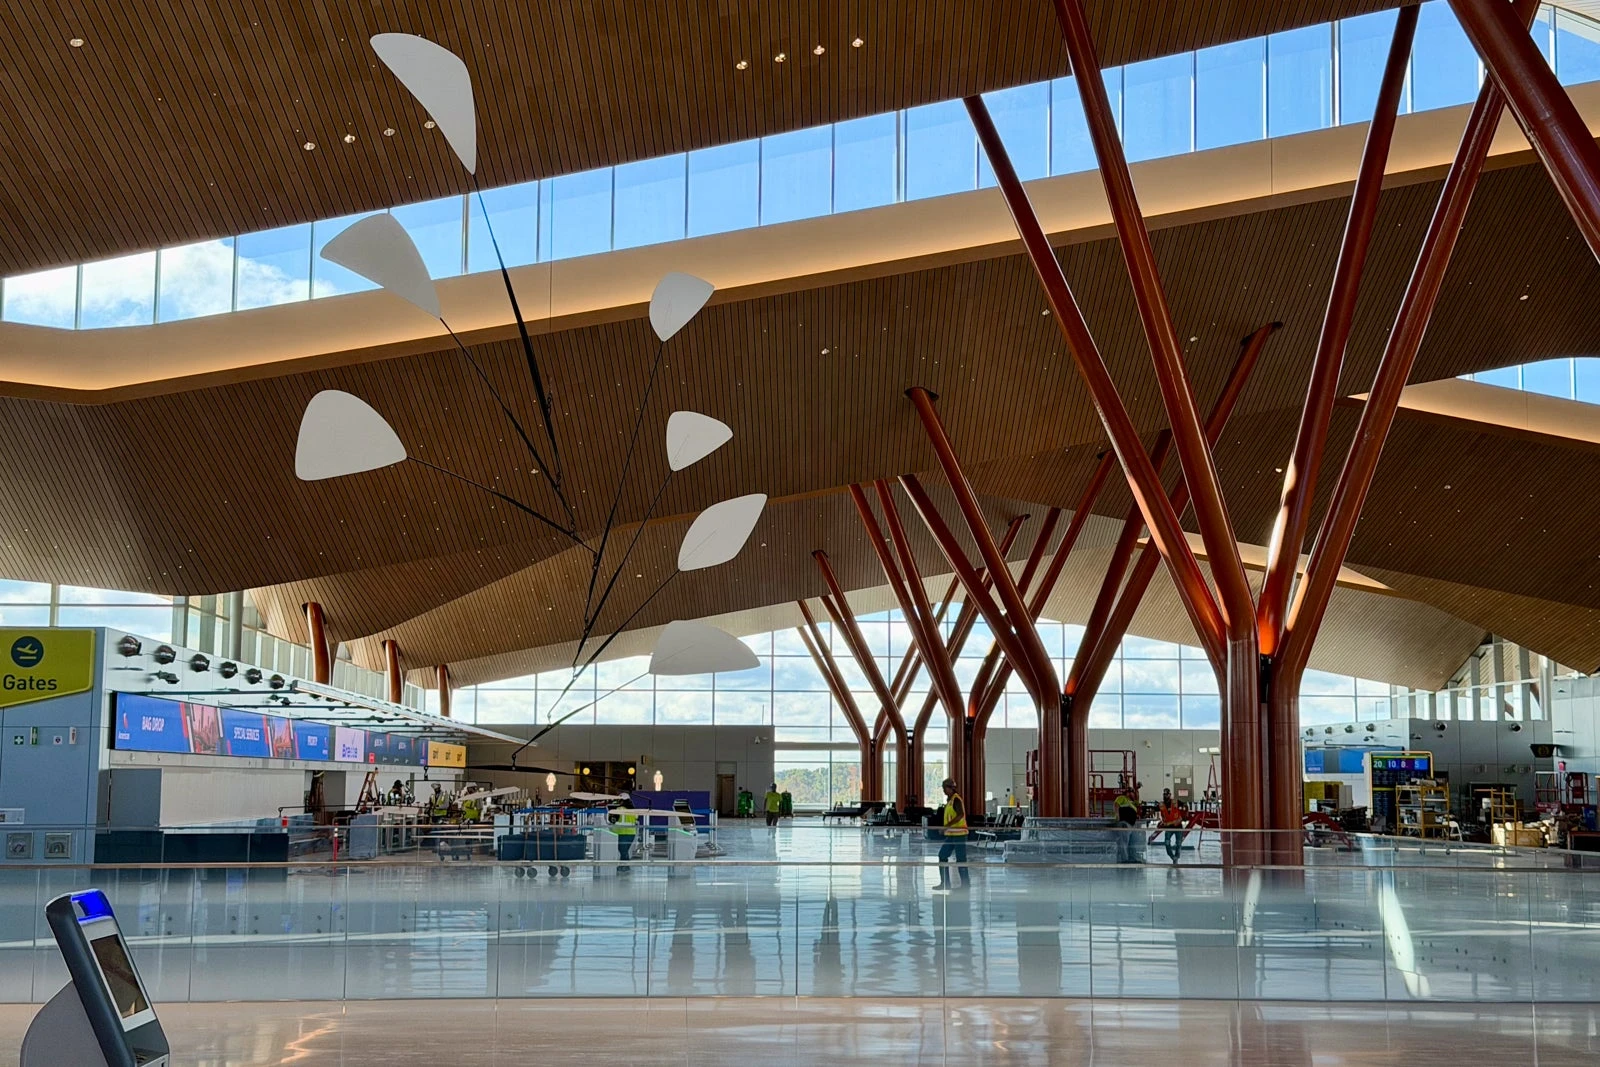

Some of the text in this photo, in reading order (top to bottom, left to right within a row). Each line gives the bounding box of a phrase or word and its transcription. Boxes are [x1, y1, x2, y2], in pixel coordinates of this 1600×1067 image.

[3, 674, 57, 690] Gates
[142, 716, 165, 732] BAG DROP
[1373, 760, 1383, 768] 20
[1388, 760, 1397, 768] 10
